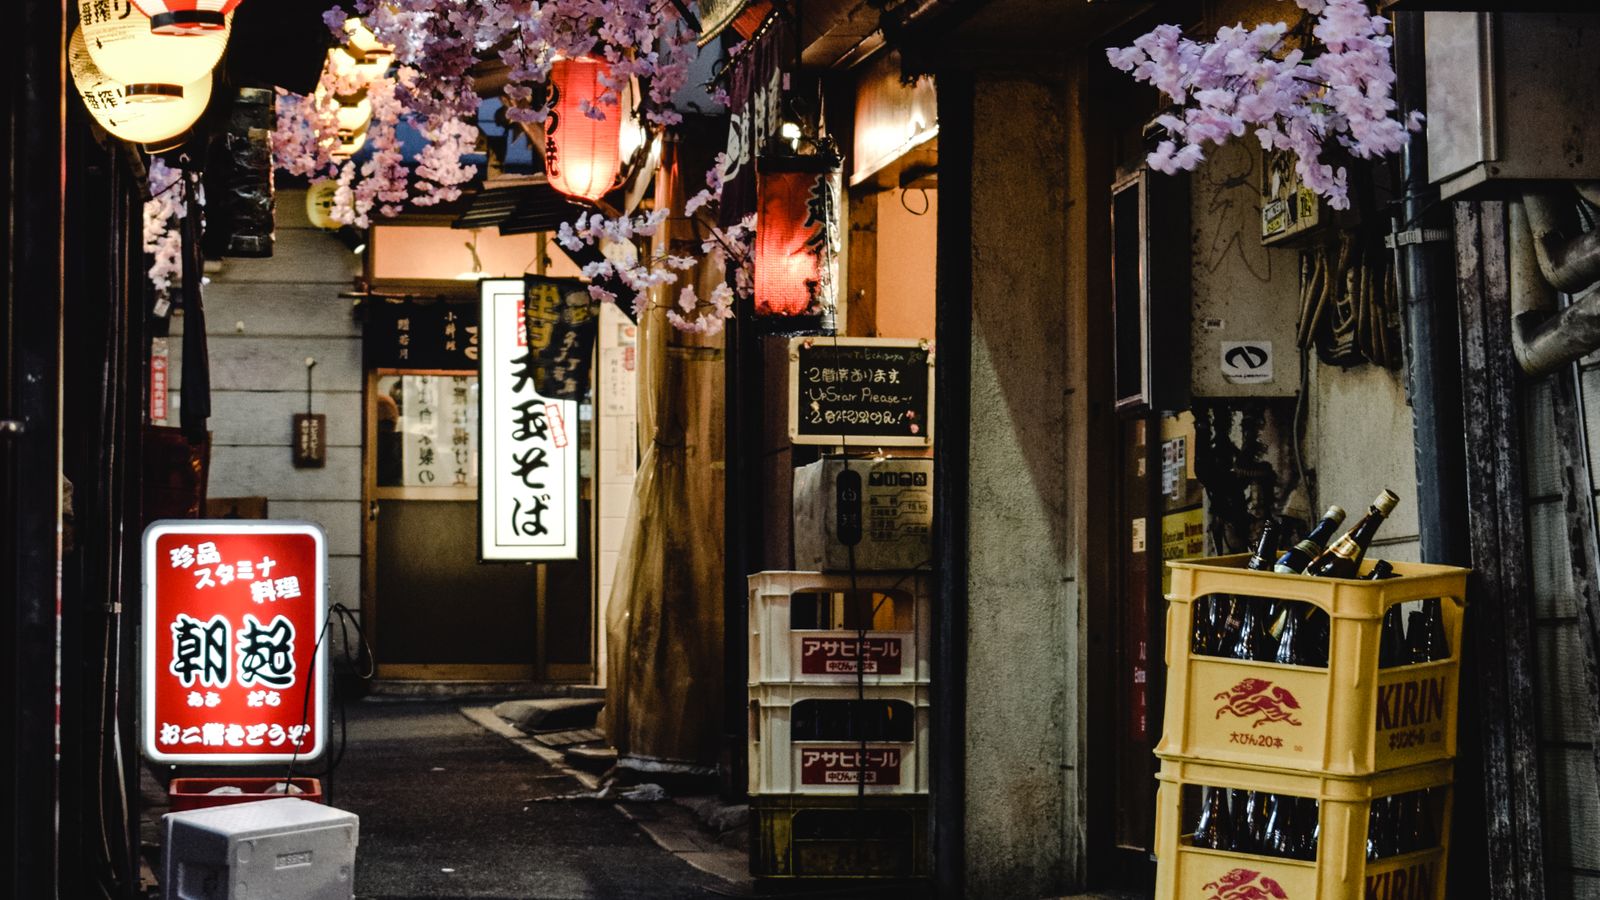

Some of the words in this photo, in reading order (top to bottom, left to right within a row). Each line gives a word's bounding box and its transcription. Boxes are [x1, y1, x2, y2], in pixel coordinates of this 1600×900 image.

[169, 541, 221, 568] 珍品
[193, 556, 276, 589] スタミナ
[250, 575, 301, 603] 料理
[171, 615, 295, 687] 朝起
[1377, 677, 1446, 731] KIRIN
[159, 722, 311, 747] お二階をどうぞ
[1229, 731, 1283, 749] 大びん20本
